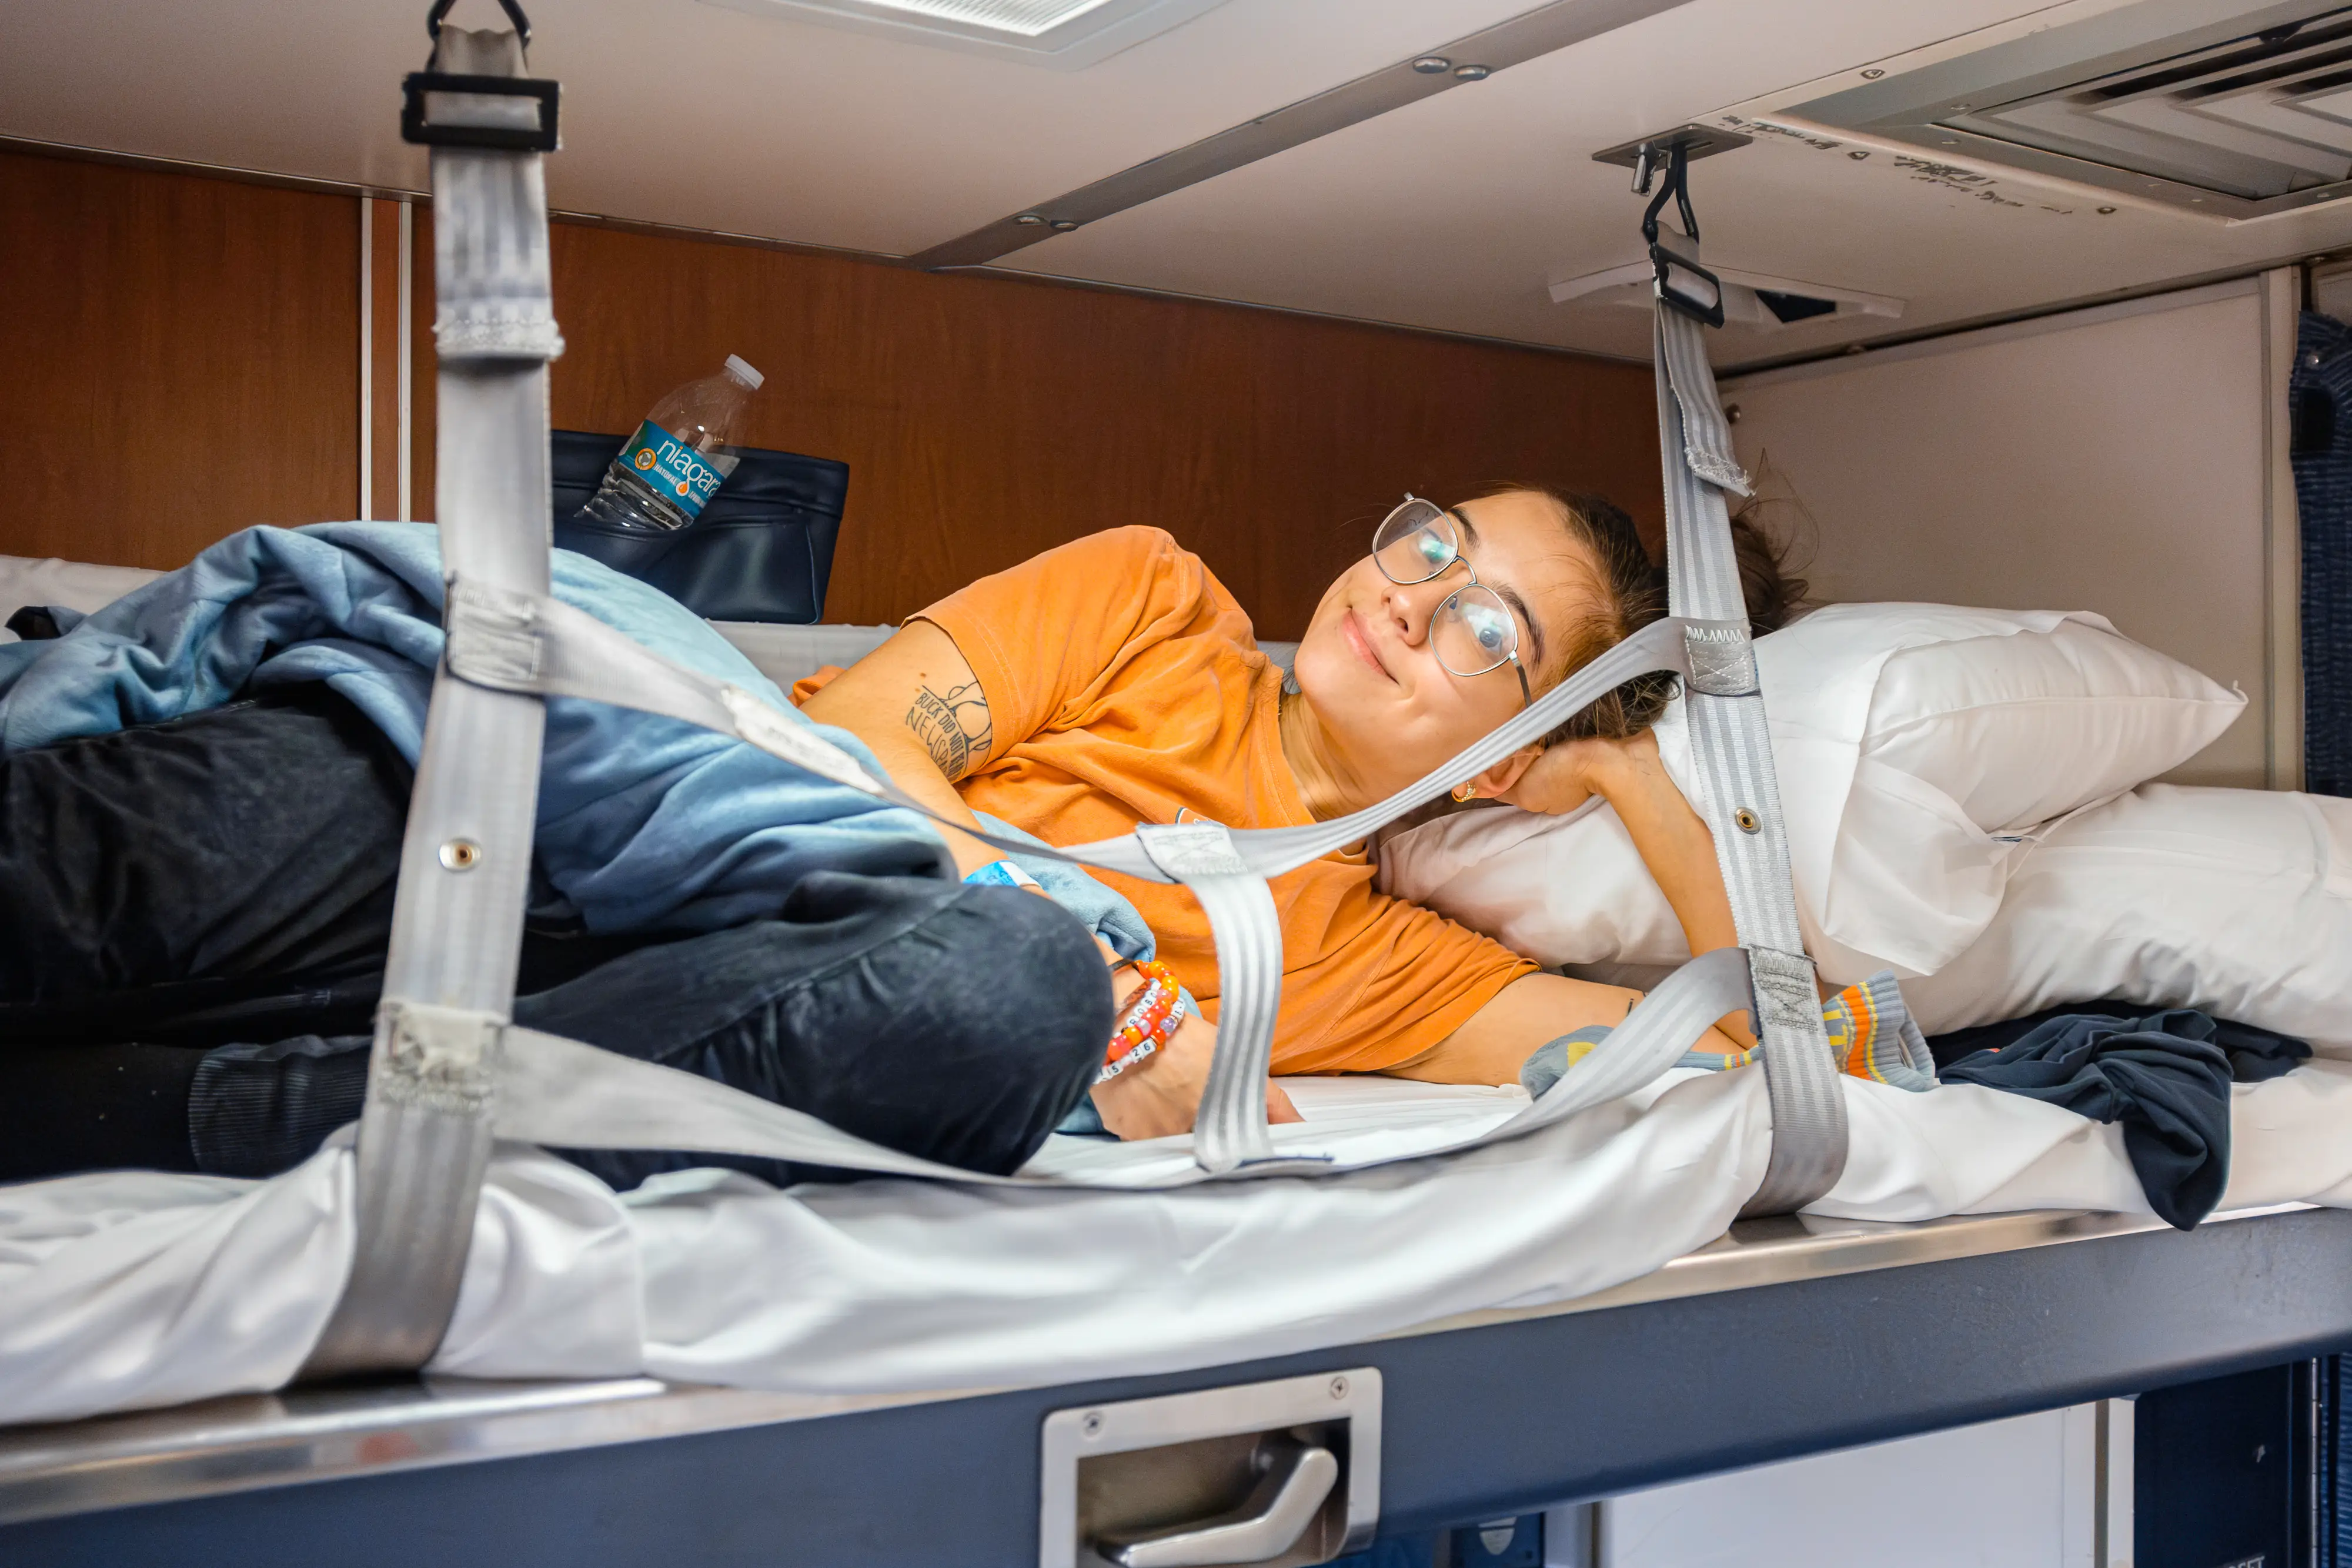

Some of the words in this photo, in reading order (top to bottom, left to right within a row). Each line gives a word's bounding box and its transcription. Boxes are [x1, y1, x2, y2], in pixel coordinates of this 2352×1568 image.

[657, 440, 721, 497] niagara
[915, 692, 944, 719] BUCK
[938, 713, 957, 734] DID
[949, 731, 964, 756] NOT
